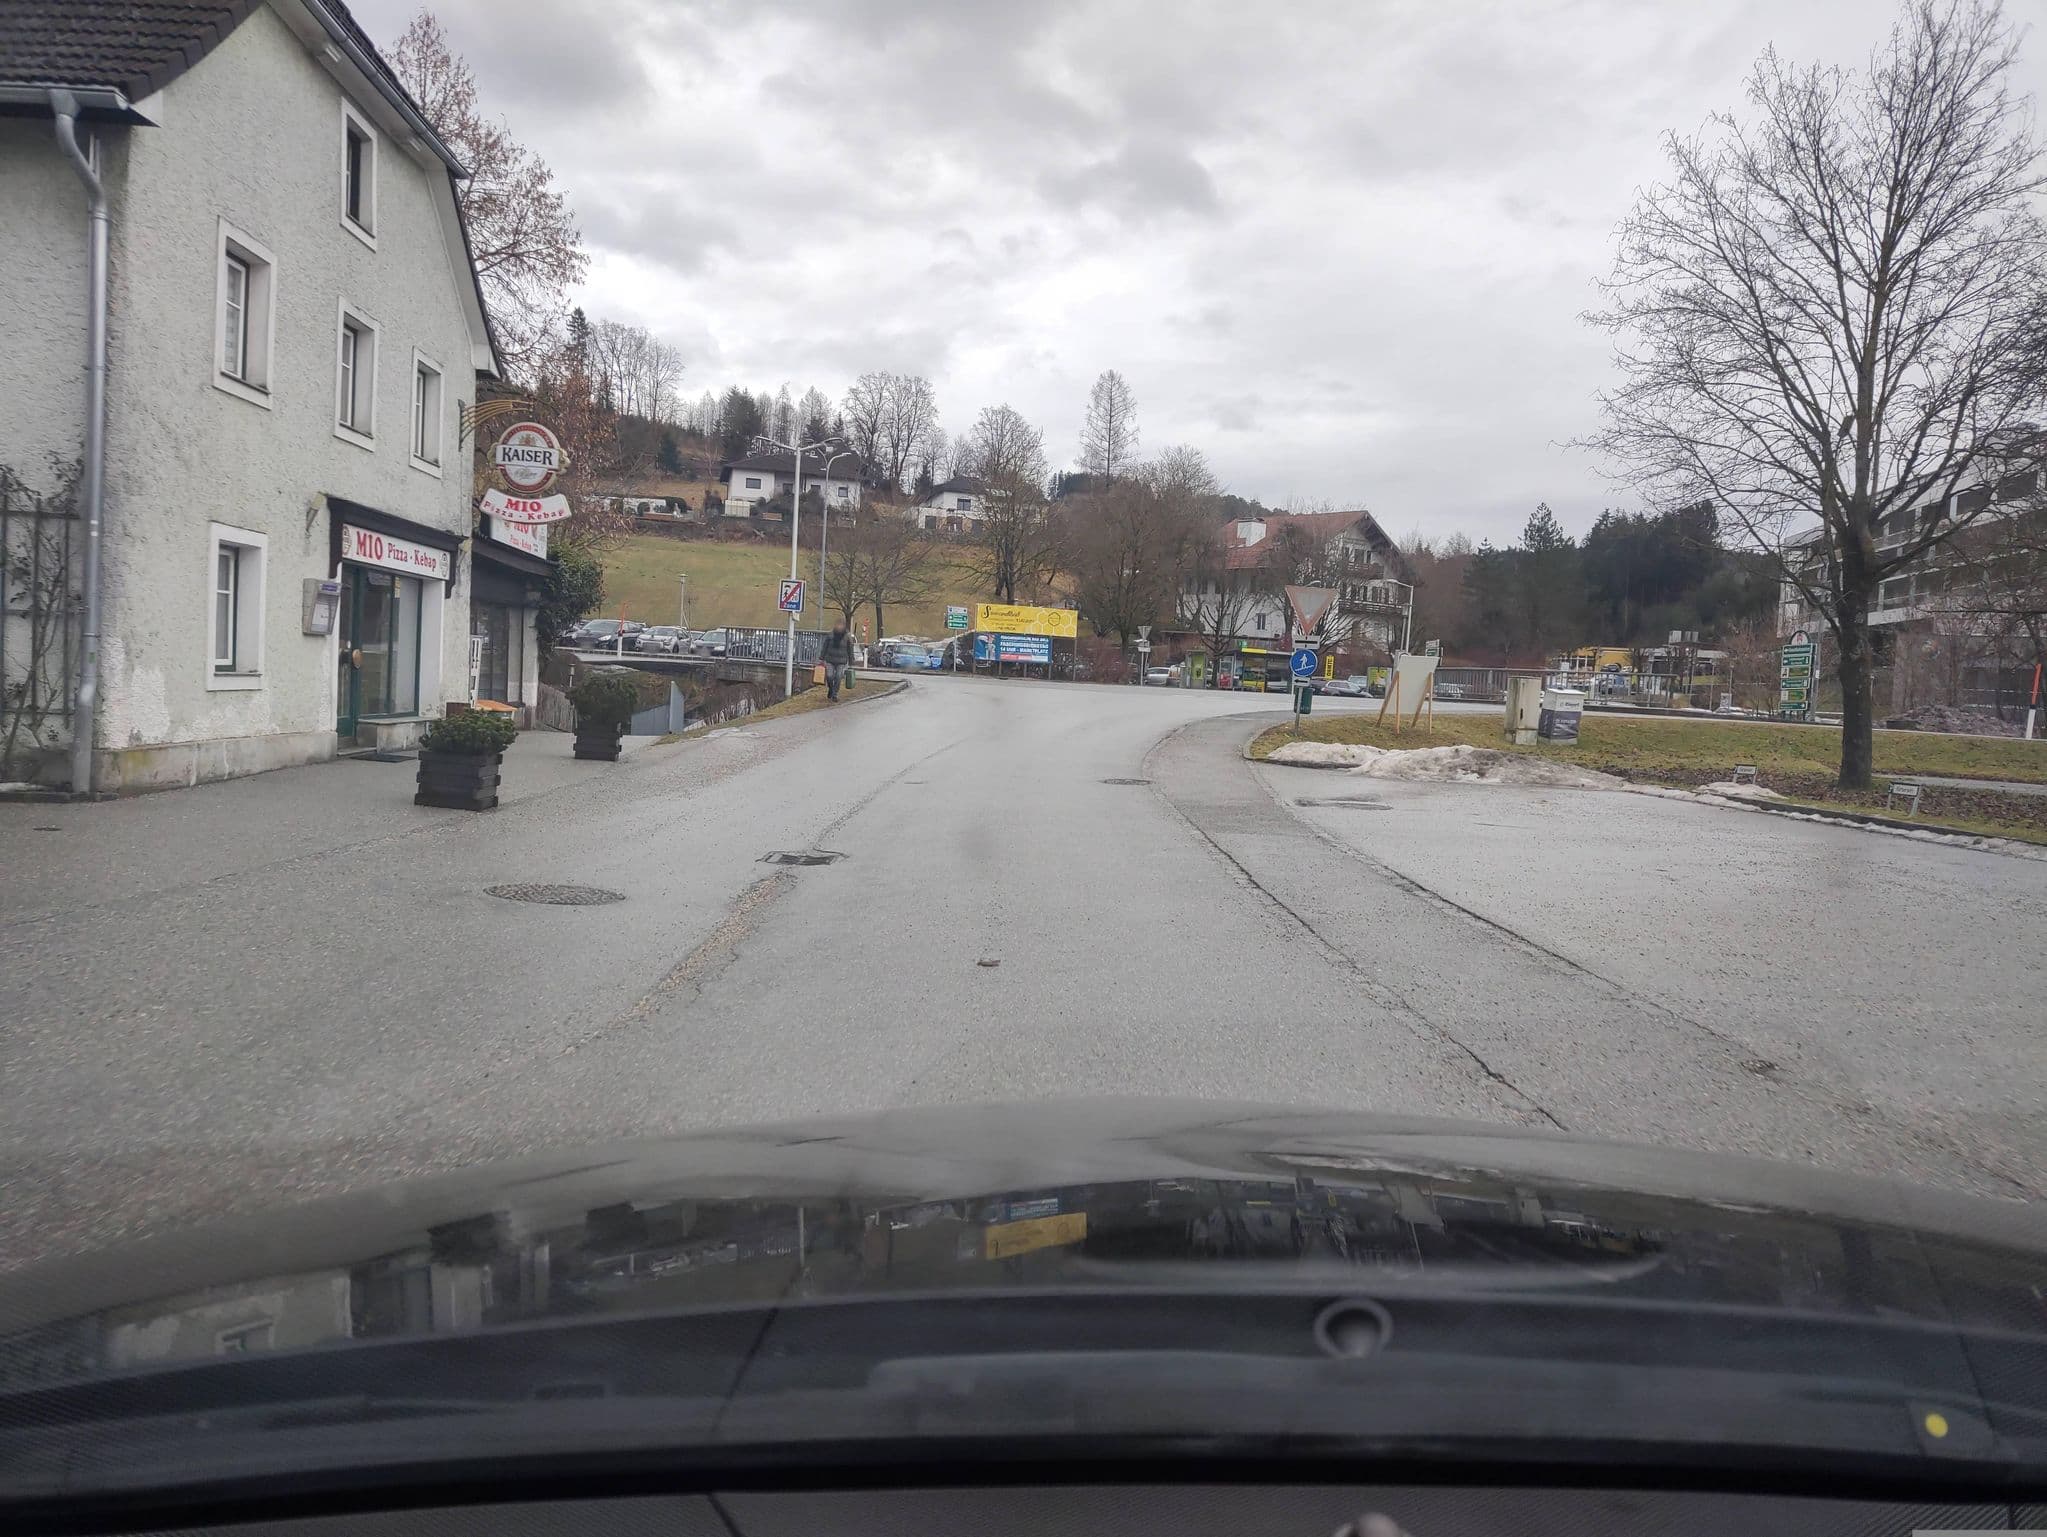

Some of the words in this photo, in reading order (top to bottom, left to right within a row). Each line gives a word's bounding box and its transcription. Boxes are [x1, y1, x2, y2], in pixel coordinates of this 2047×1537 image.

[502, 447, 553, 466] KAISER
[484, 501, 513, 518] Pizza
[505, 498, 542, 512] MIO
[356, 531, 383, 560] MIO
[387, 542, 408, 562] Pizza
[414, 549, 437, 572] Kebap
